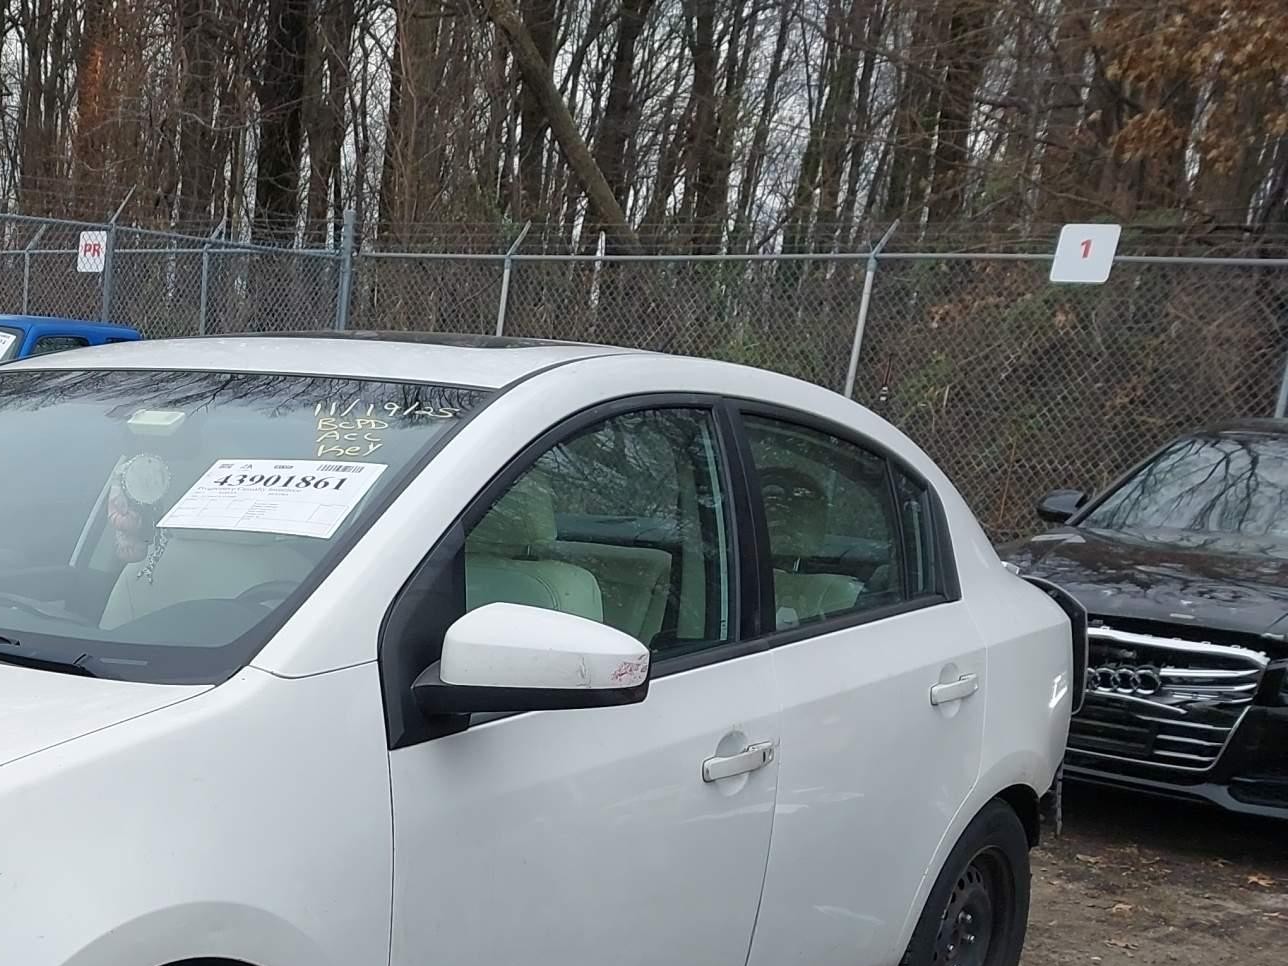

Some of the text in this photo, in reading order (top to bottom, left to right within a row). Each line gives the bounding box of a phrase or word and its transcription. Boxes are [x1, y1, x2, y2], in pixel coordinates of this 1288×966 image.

[83, 243, 101, 257] PR
[1081, 239, 1092, 259] 1
[213, 474, 349, 491] 43901861
